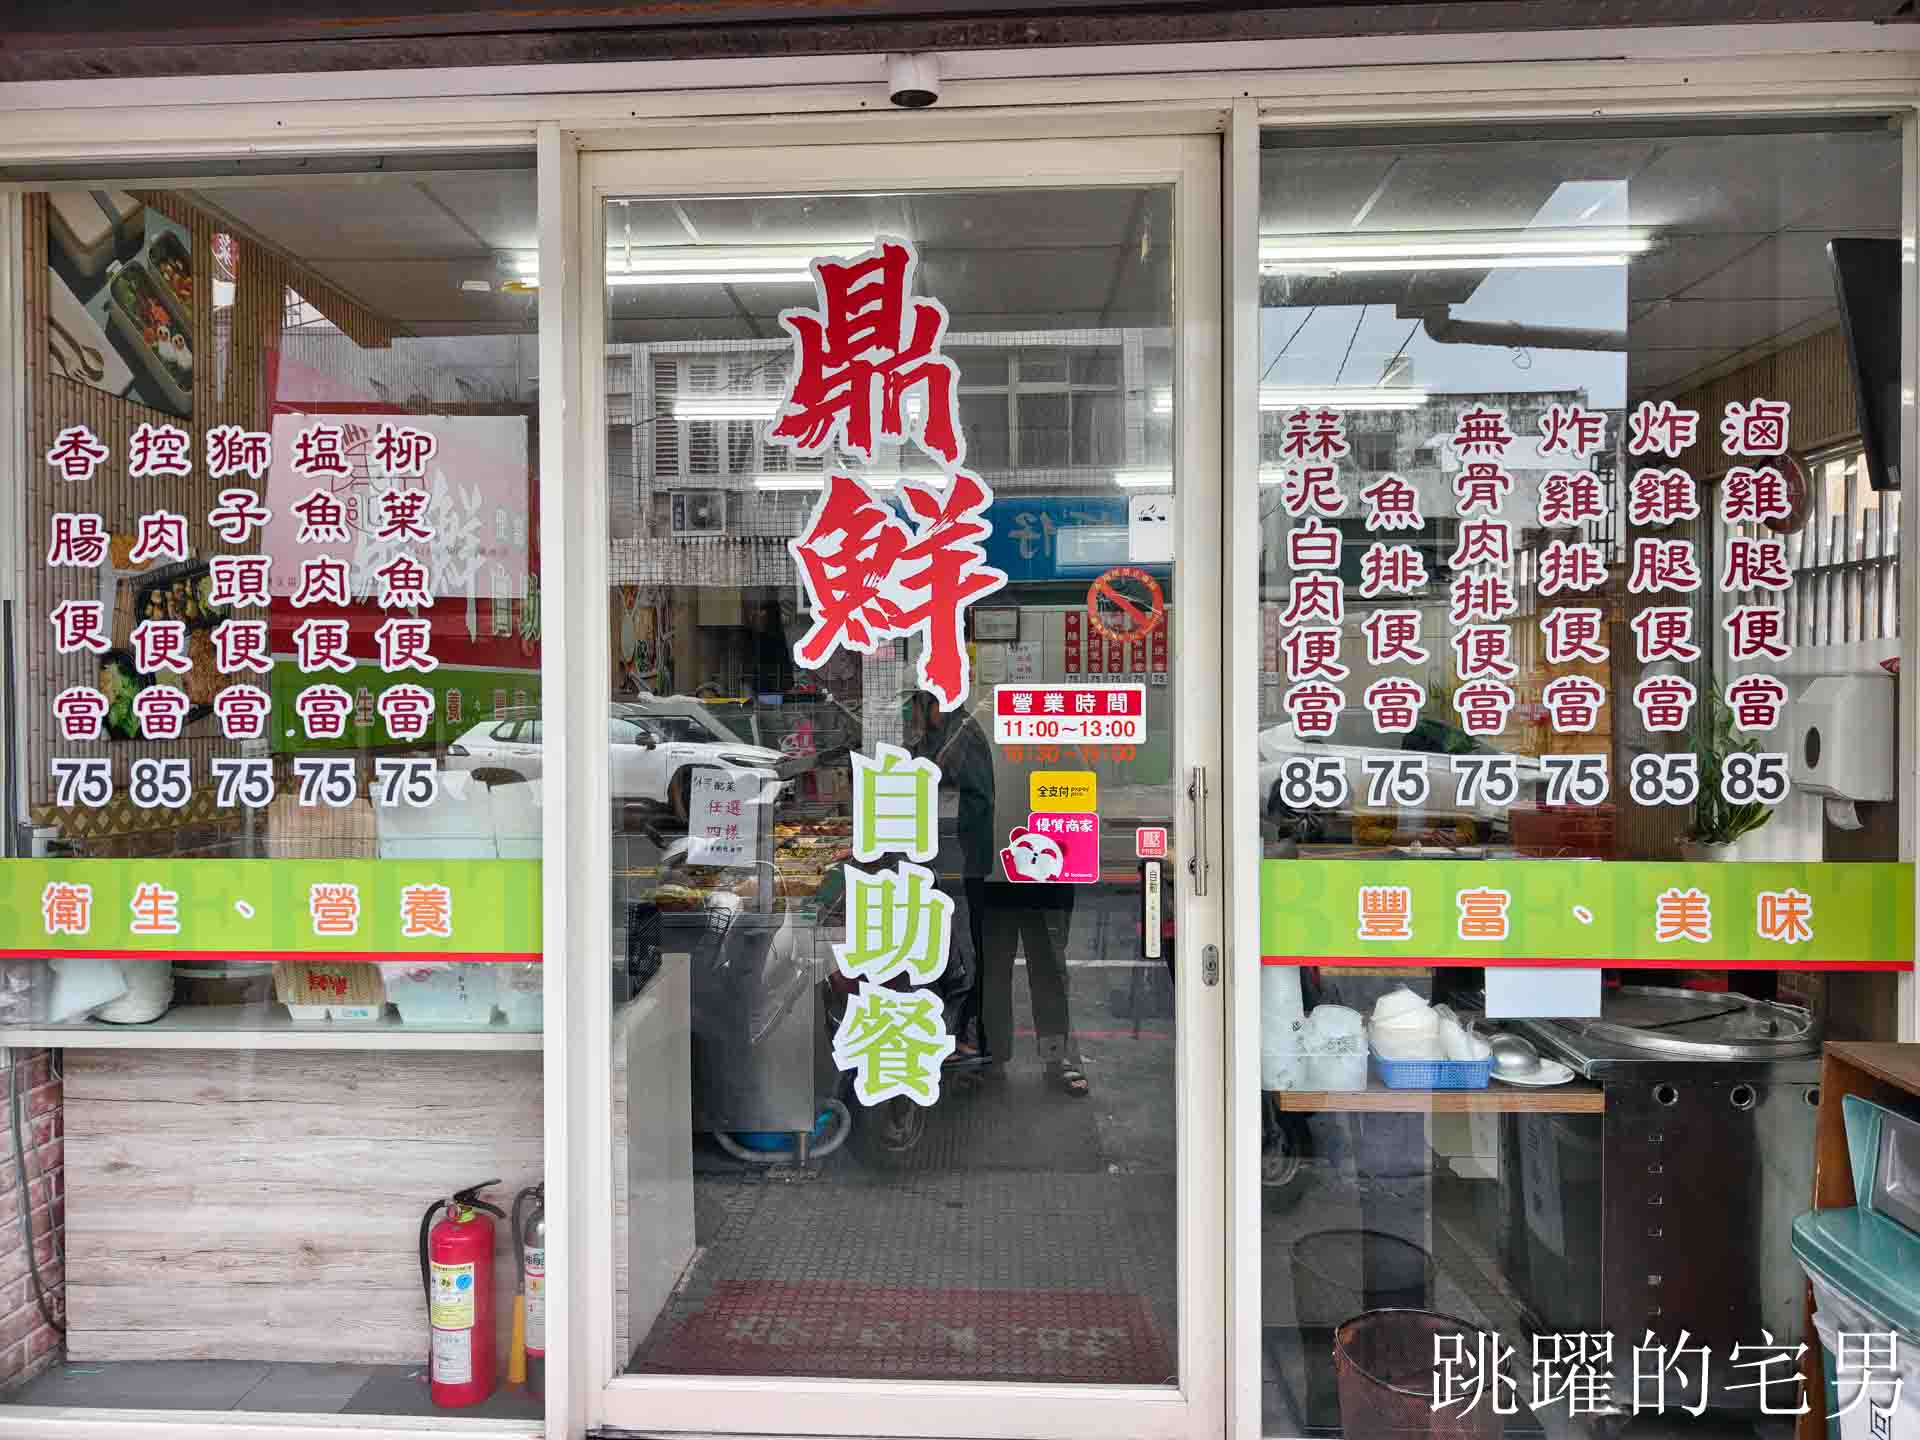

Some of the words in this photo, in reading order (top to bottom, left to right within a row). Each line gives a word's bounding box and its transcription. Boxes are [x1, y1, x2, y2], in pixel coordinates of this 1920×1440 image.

[769, 240, 1003, 707] 鼎鮮
[50, 429, 106, 737] 香腸便當
[133, 429, 188, 736] 控肉便當
[209, 429, 269, 736] 獅子頭便當
[293, 429, 350, 736] 塩魚肉便當
[375, 429, 435, 736] 柳葉魚便當
[1283, 409, 1345, 734] 蒜泥白肉便當
[1453, 409, 1514, 732] 無骨肉排便當
[1541, 406, 1607, 729] 炸雞排便當
[1632, 405, 1698, 729] 炸雞腿便當
[1724, 401, 1789, 729] 滷雞腿便當
[1362, 480, 1424, 730] 魚排便當
[1011, 692, 1129, 715] 營業時間
[55, 761, 111, 804] 75
[134, 761, 189, 804] 85
[215, 761, 272, 804] 75
[297, 761, 354, 804] 75
[378, 761, 435, 804] 75
[1036, 785, 1070, 798] 全支付
[1280, 758, 1347, 803] 85
[1365, 758, 1426, 801] 75
[1452, 758, 1515, 801] 75
[1545, 757, 1607, 801] 75
[1631, 756, 1698, 802] 85
[1724, 755, 1789, 800] 85
[1036, 817, 1094, 833] 優質商家
[43, 883, 451, 936] 衛生、營養
[843, 752, 948, 1099] 自助餐
[1359, 886, 1812, 940] 豐富、美味
